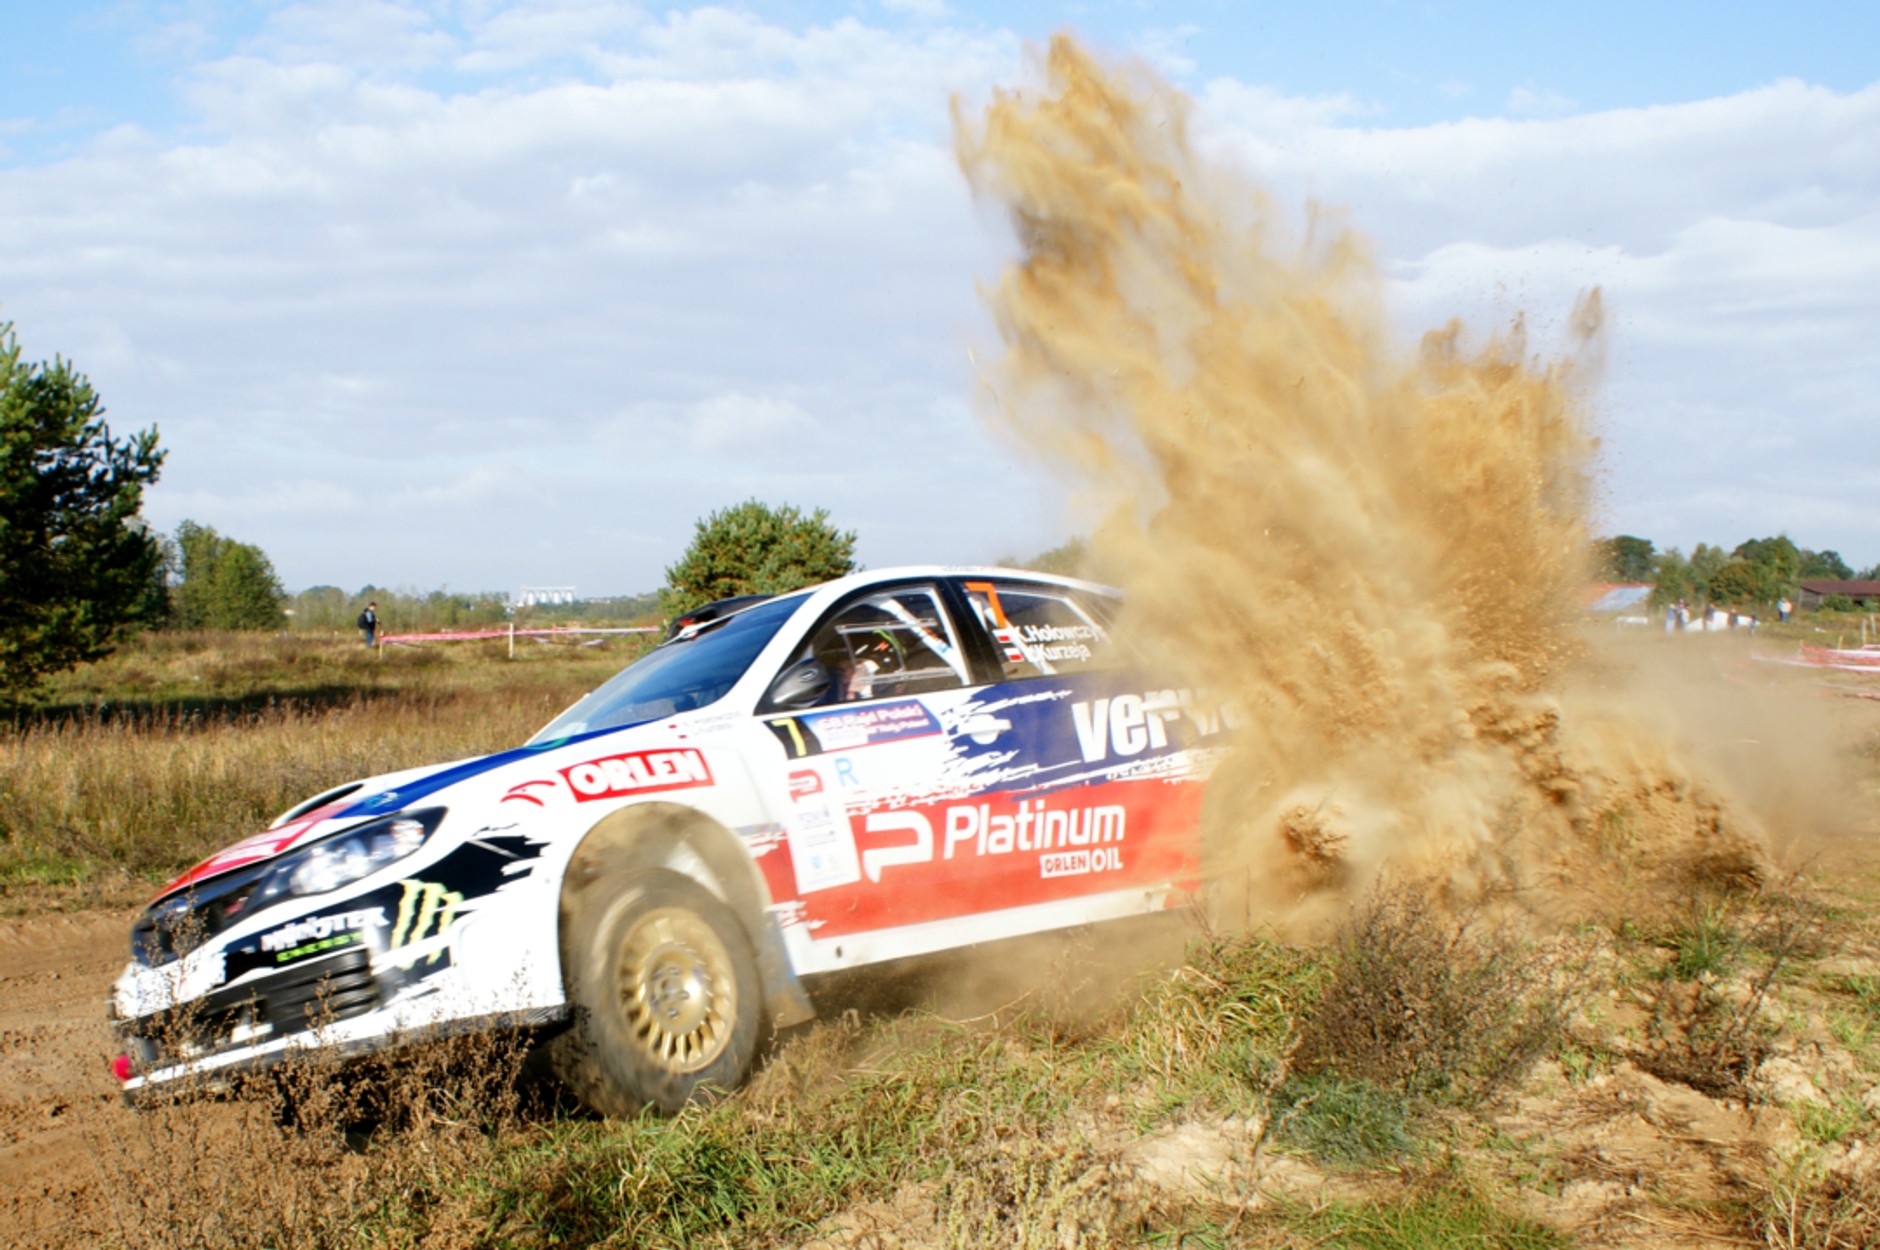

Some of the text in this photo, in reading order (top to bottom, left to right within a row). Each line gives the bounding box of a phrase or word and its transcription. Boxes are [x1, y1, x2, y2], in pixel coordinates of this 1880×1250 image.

[965, 582, 1008, 629] 7
[771, 716, 807, 757] 7
[569, 750, 708, 795] ORLEN
[834, 757, 859, 787] R
[943, 799, 1126, 860] Platinum
[1043, 847, 1124, 875] ORLEN OIL
